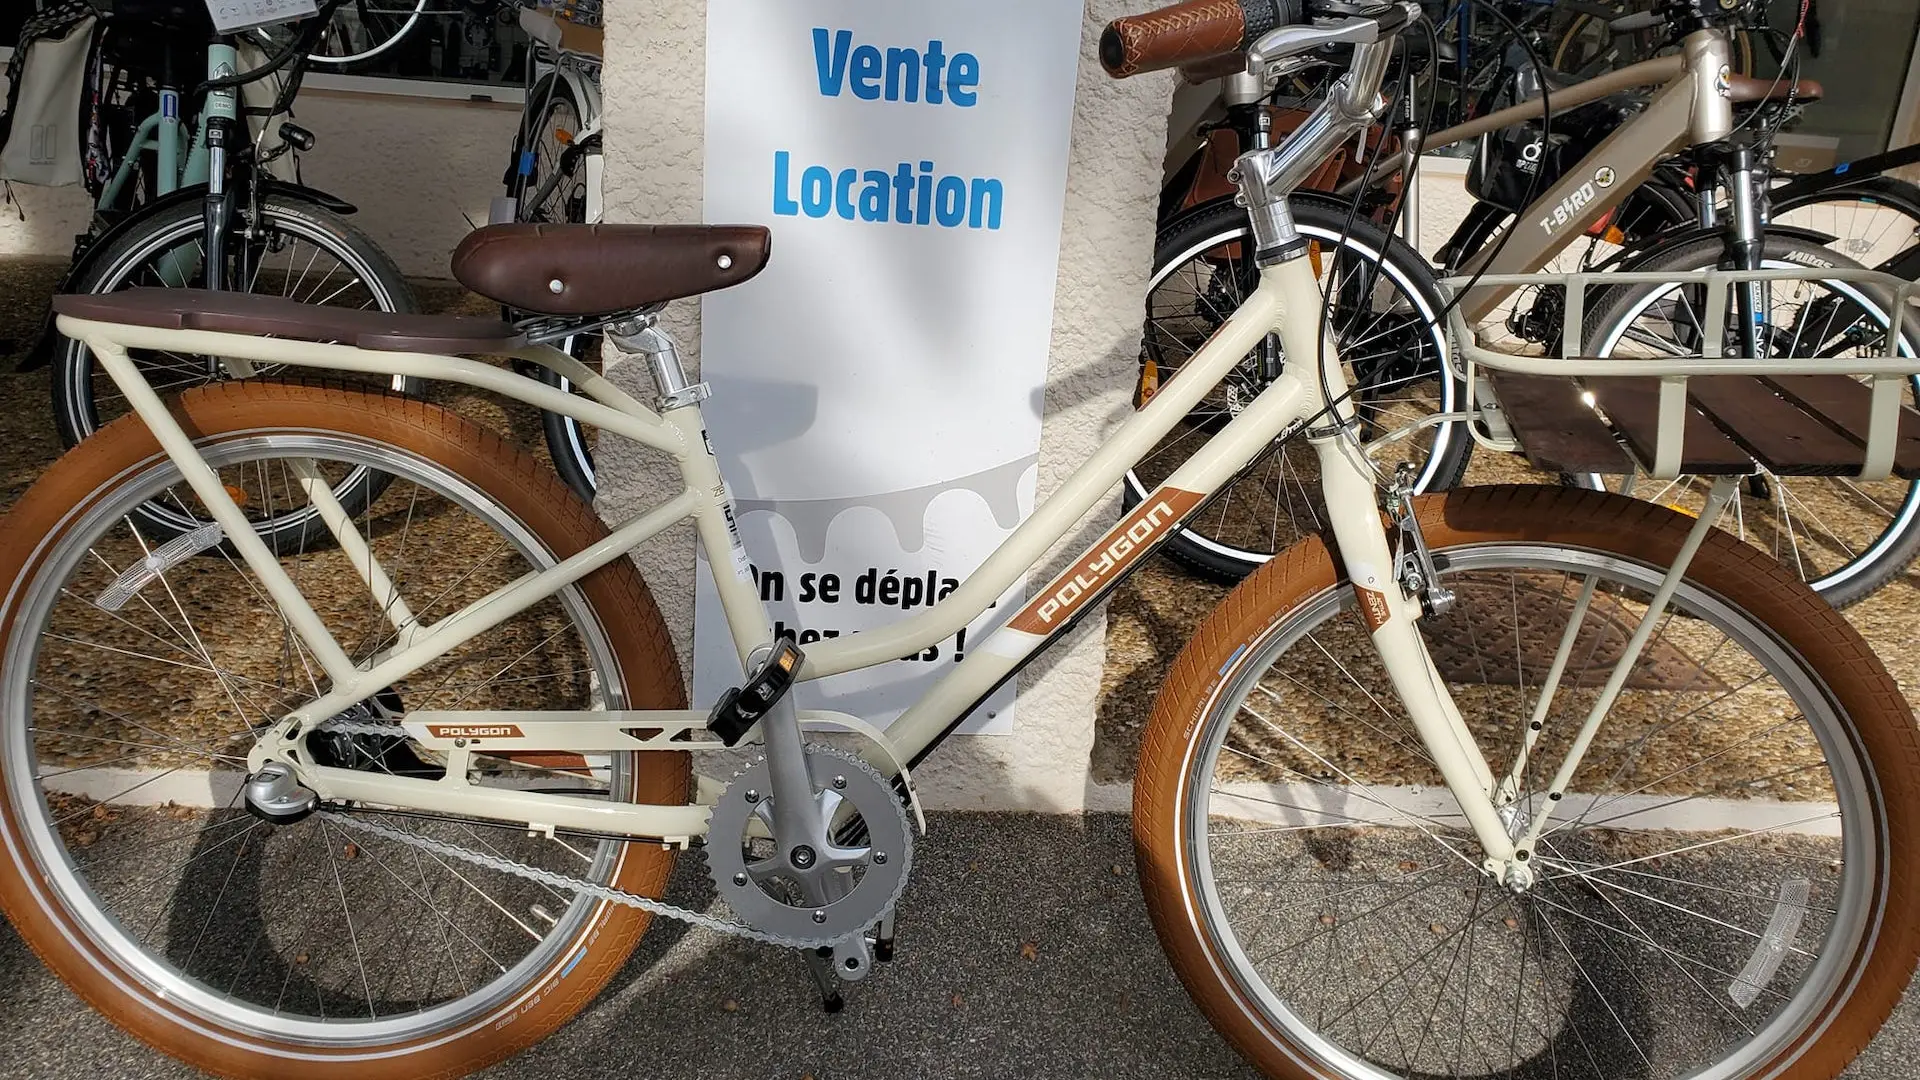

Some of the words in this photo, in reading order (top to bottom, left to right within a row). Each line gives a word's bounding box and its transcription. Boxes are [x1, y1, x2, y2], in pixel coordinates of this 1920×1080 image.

[812, 28, 980, 107] Vente
[773, 150, 1004, 230] Location
[799, 572, 840, 603] se
[855, 567, 996, 609] dépla
[1036, 500, 1174, 624] POLYGON
[439, 727, 511, 736] POLYGON
[1183, 678, 1217, 741] SCHWALBE
